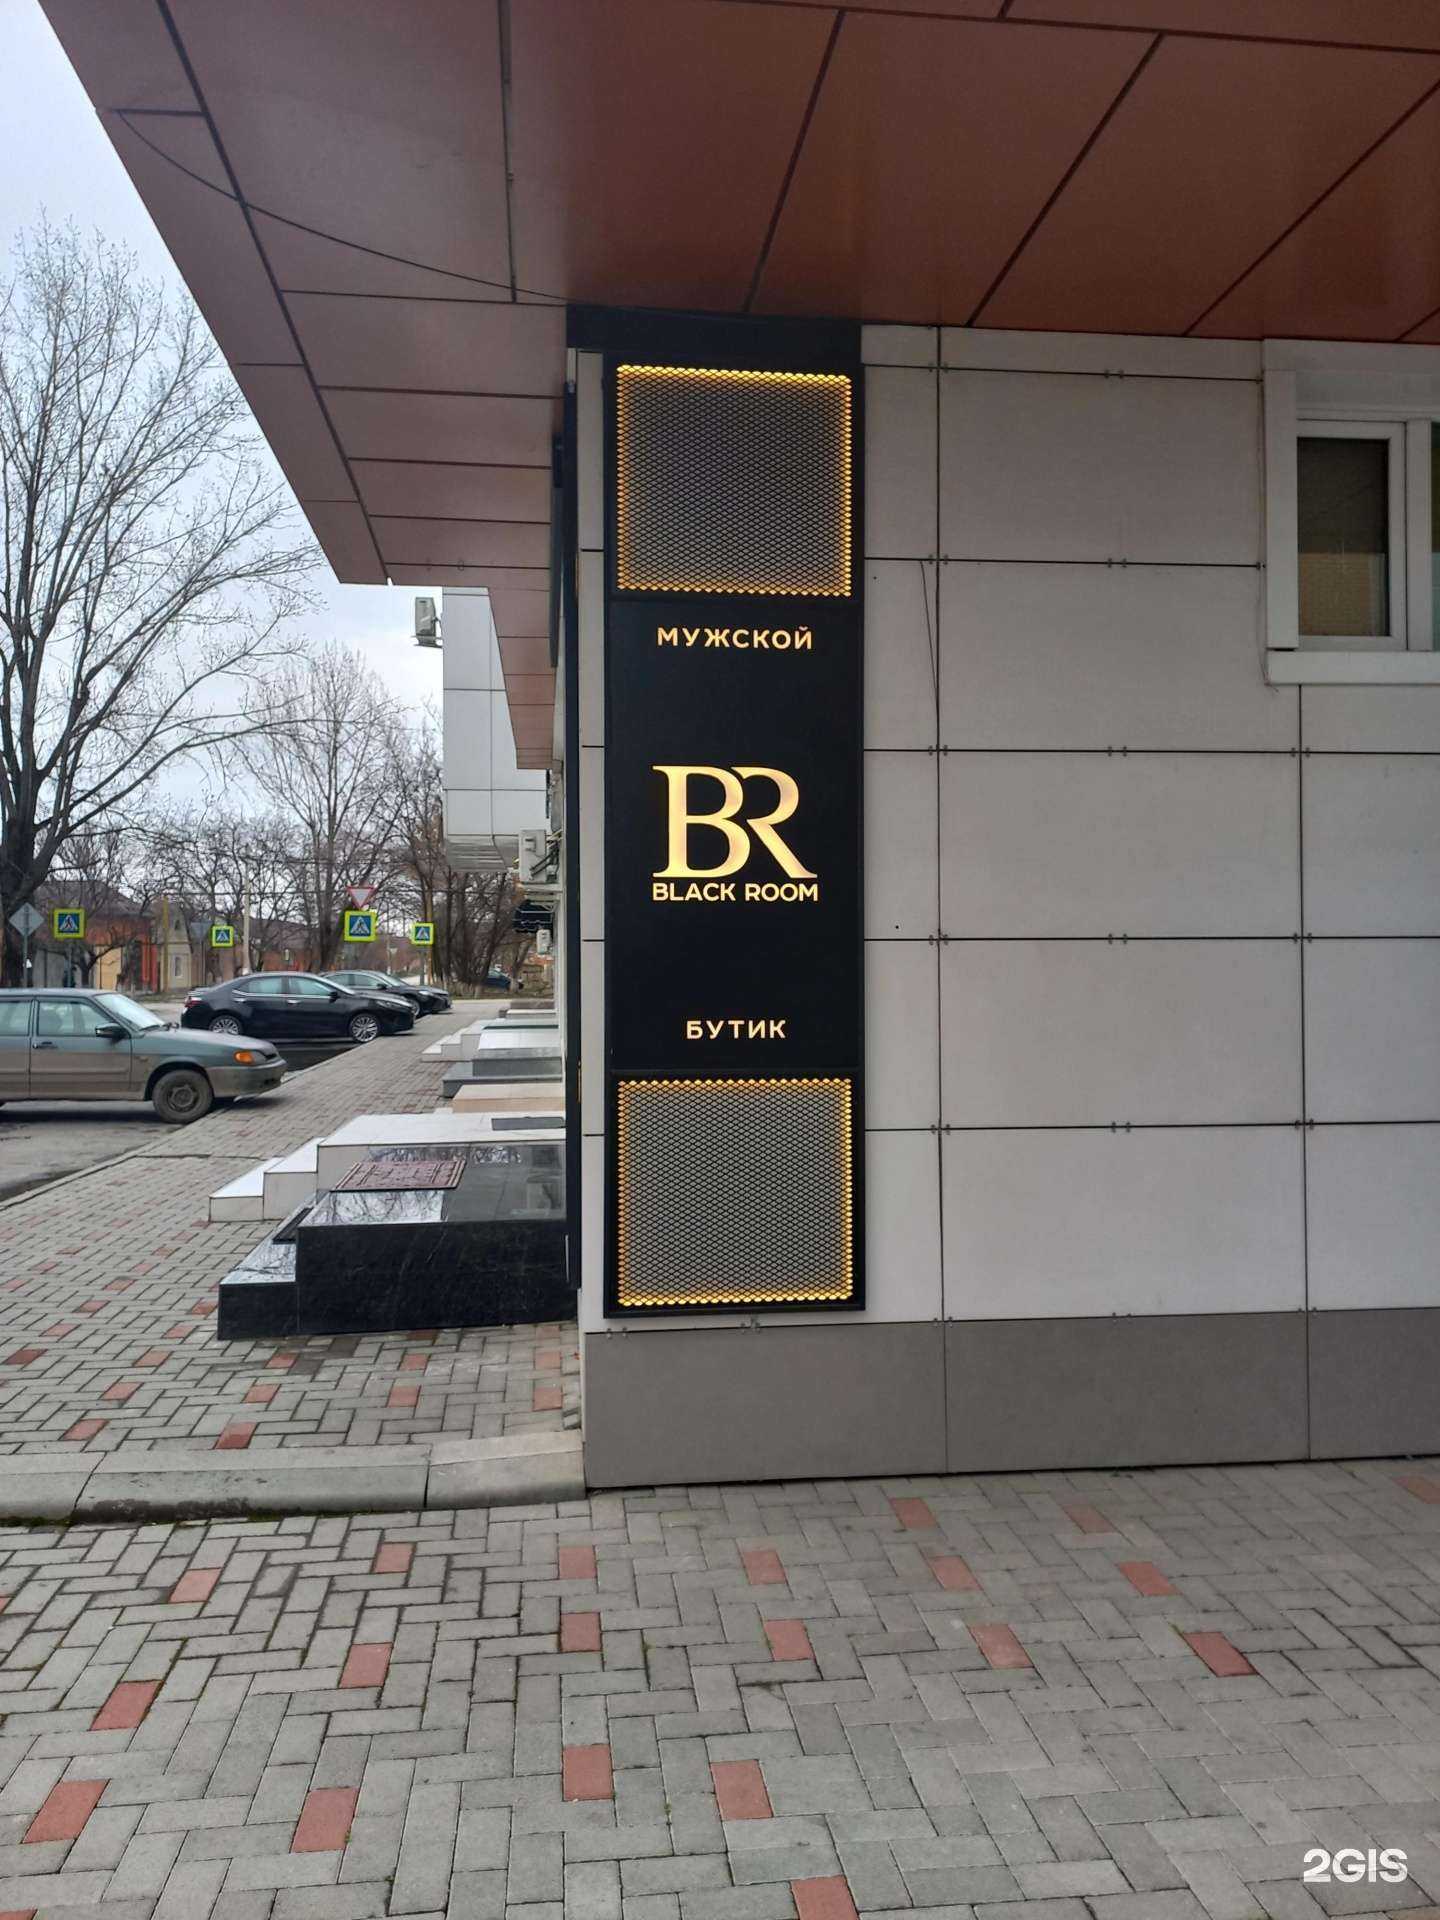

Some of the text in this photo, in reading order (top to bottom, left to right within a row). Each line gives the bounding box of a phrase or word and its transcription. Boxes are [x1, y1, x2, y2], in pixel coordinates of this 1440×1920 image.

[657, 626, 812, 650] МУЖСКОЙ
[652, 765, 818, 878] BR
[652, 882, 819, 902] BLACK ROOM
[686, 1019, 786, 1040] БУТИК
